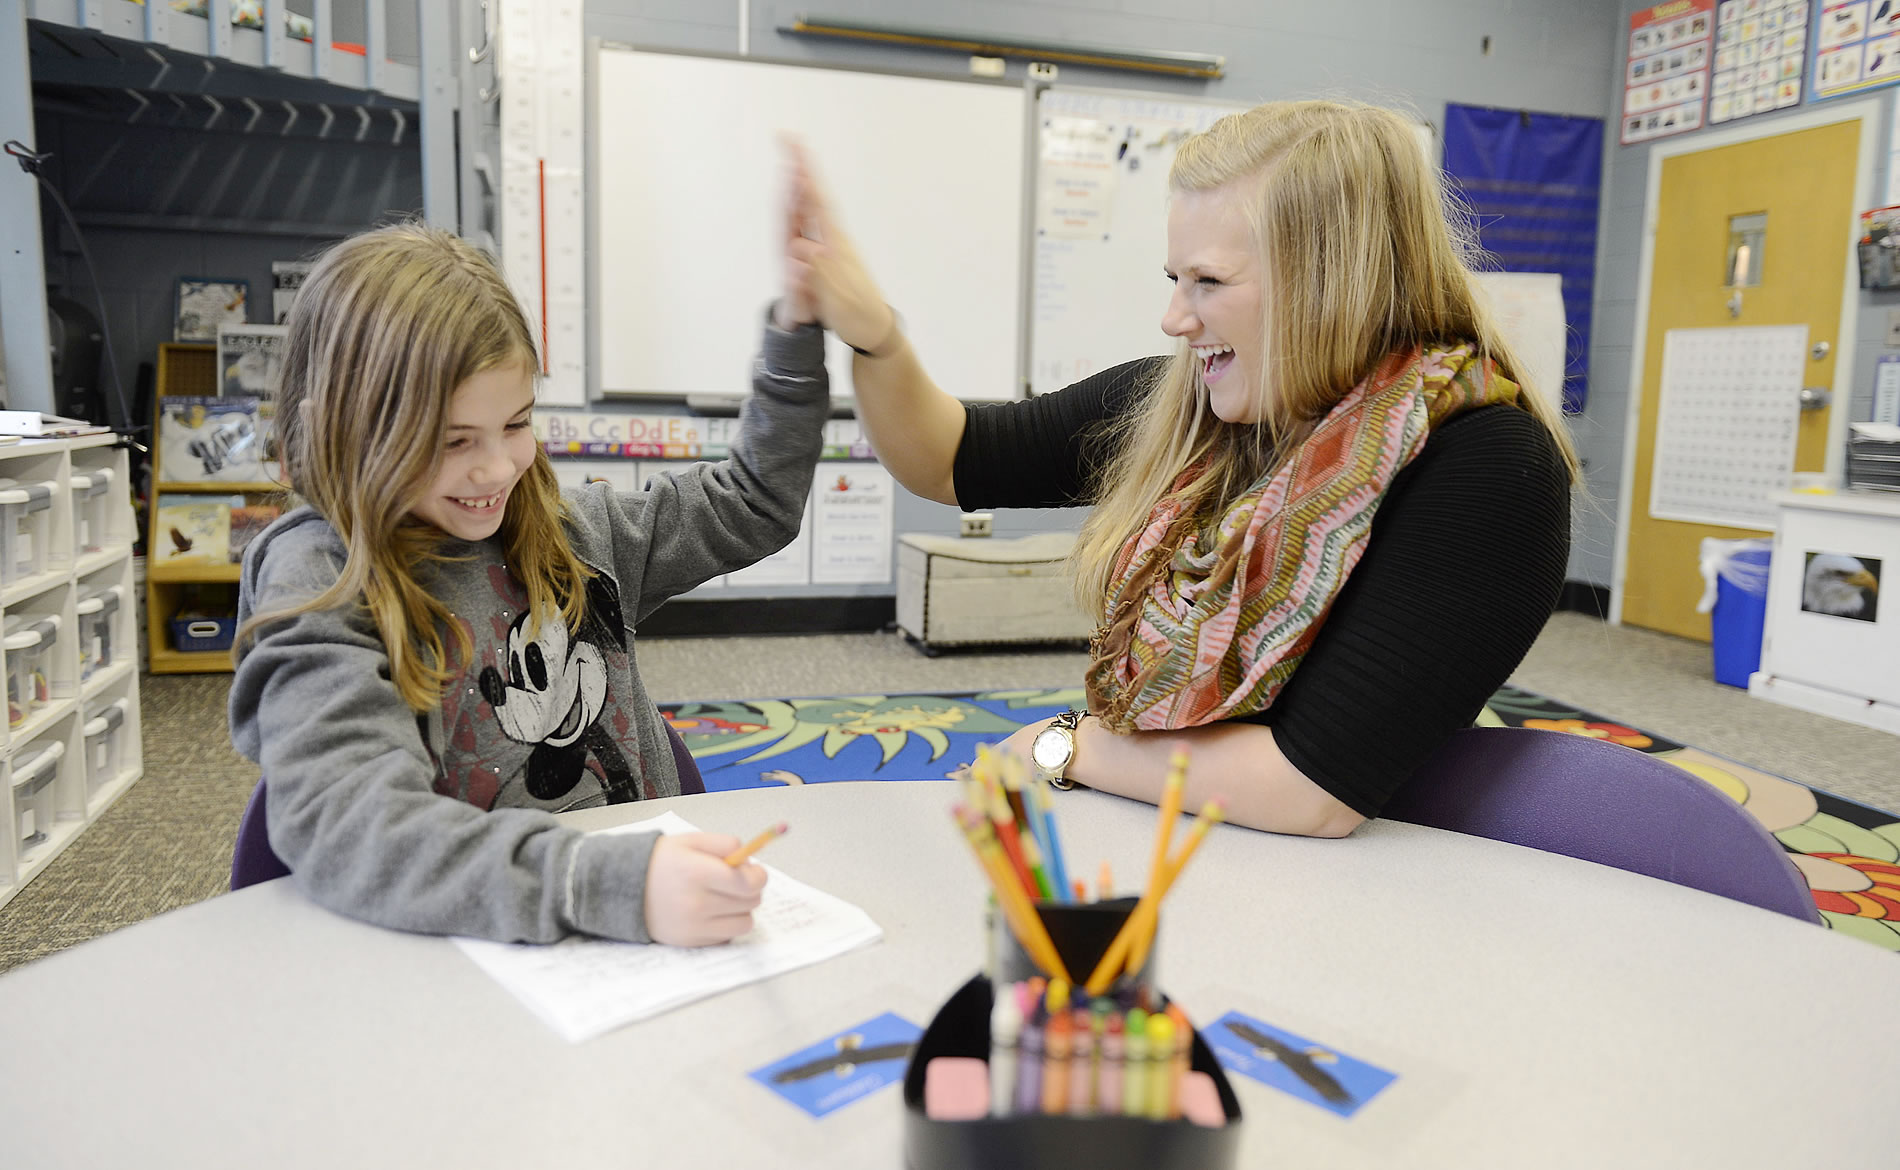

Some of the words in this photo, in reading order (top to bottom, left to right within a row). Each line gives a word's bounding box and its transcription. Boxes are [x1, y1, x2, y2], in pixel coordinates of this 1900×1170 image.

[549, 415, 579, 440] Bb
[588, 416, 621, 440] Cc
[629, 417, 663, 441] Dd
[668, 418, 698, 442] Ee
